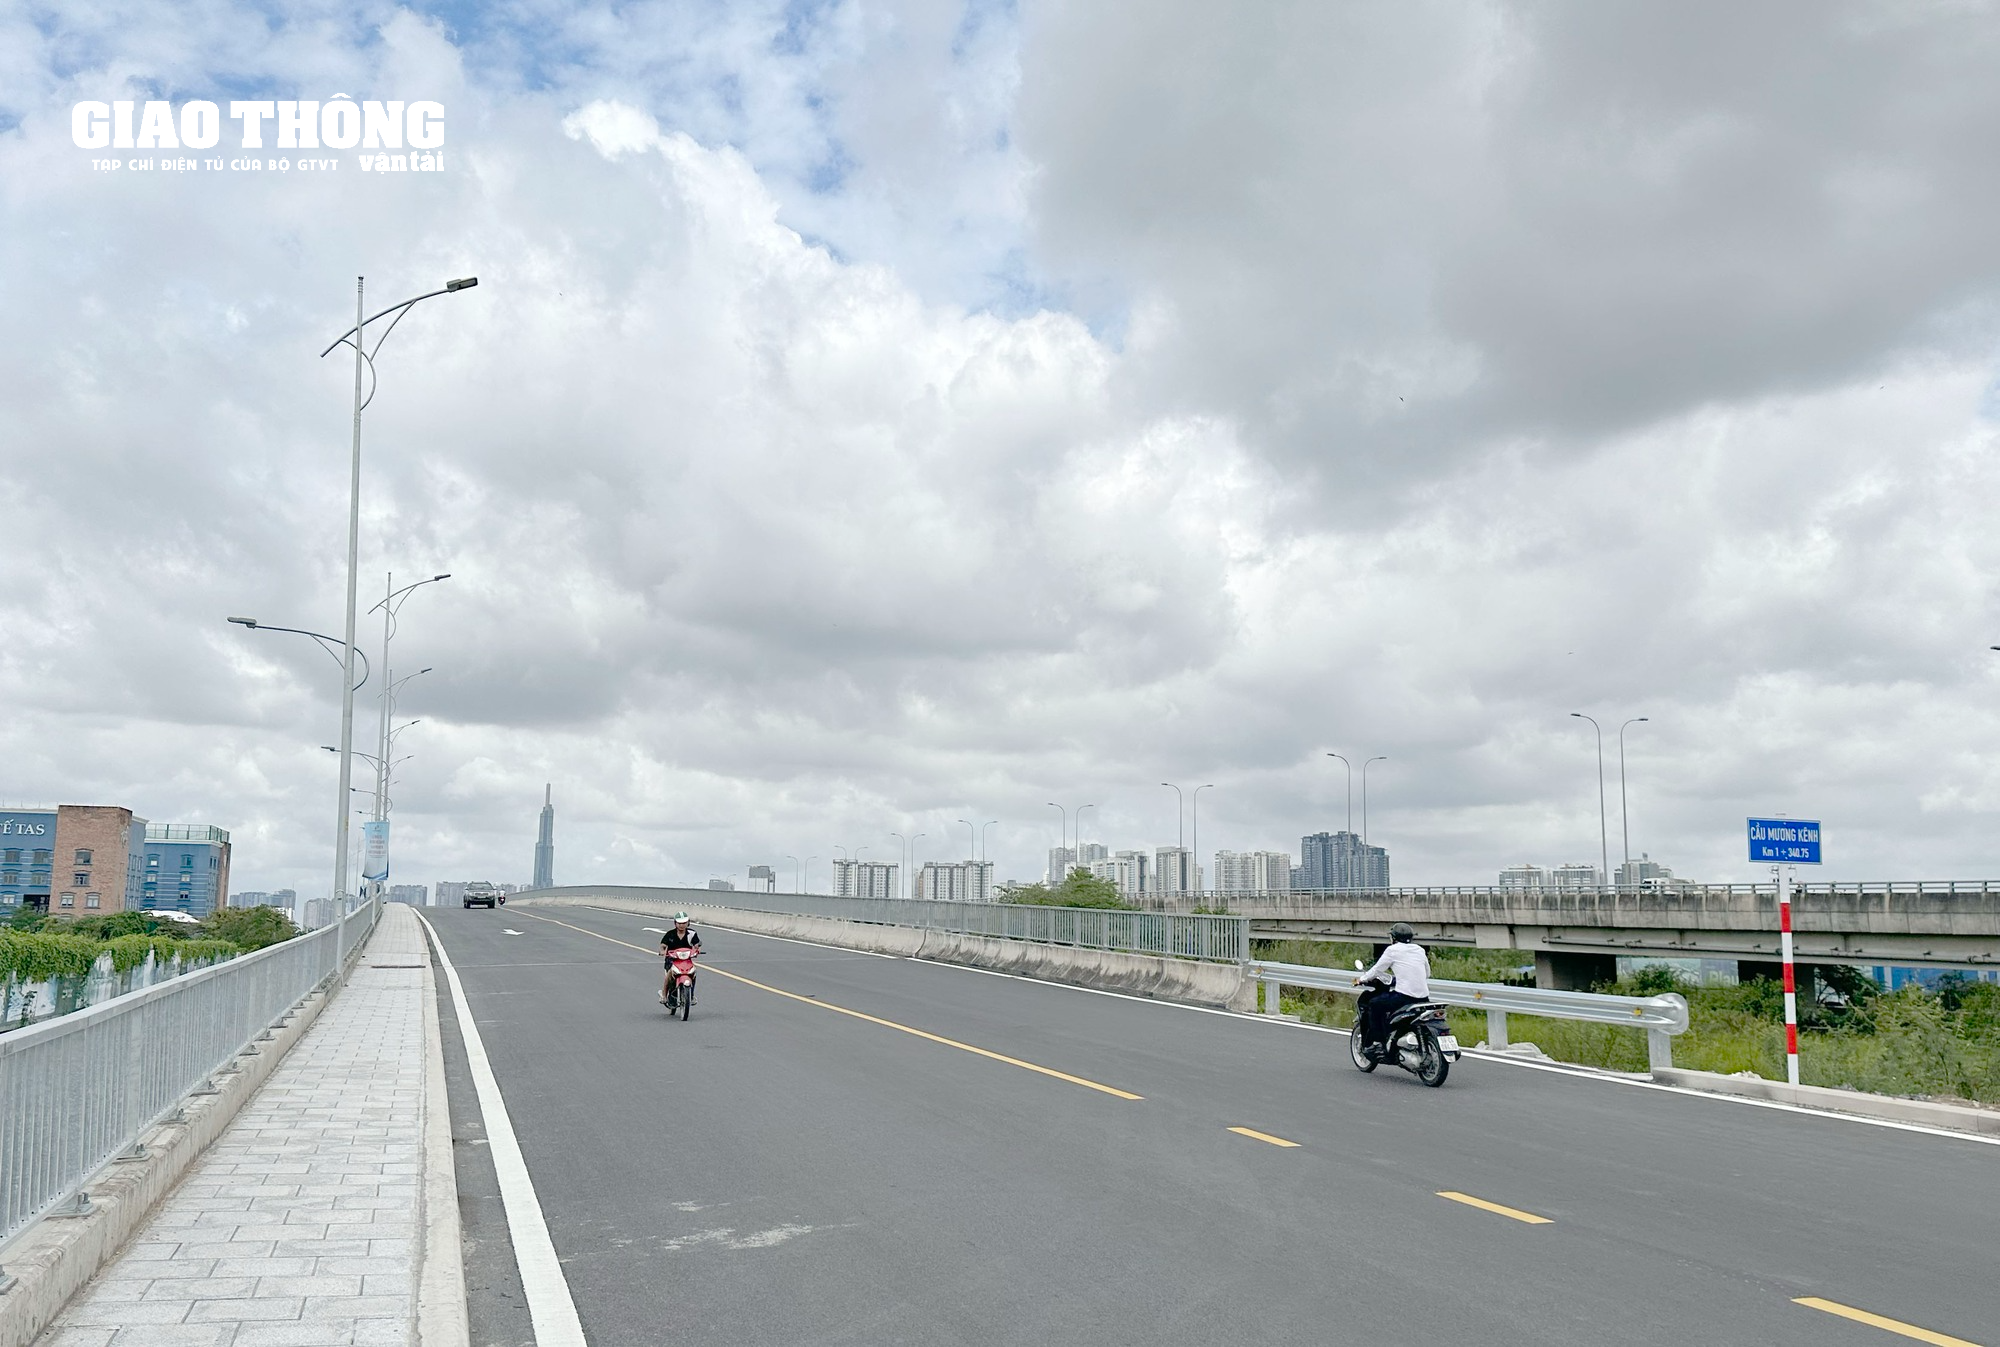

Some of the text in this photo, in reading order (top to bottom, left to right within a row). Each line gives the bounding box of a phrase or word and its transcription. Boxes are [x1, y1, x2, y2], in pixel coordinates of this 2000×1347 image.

[0, 819, 45, 835] Ế TAS
[1750, 822, 1766, 841] CẦU
[1797, 827, 1819, 843] KÊNH
[1762, 847, 1774, 857] Km
